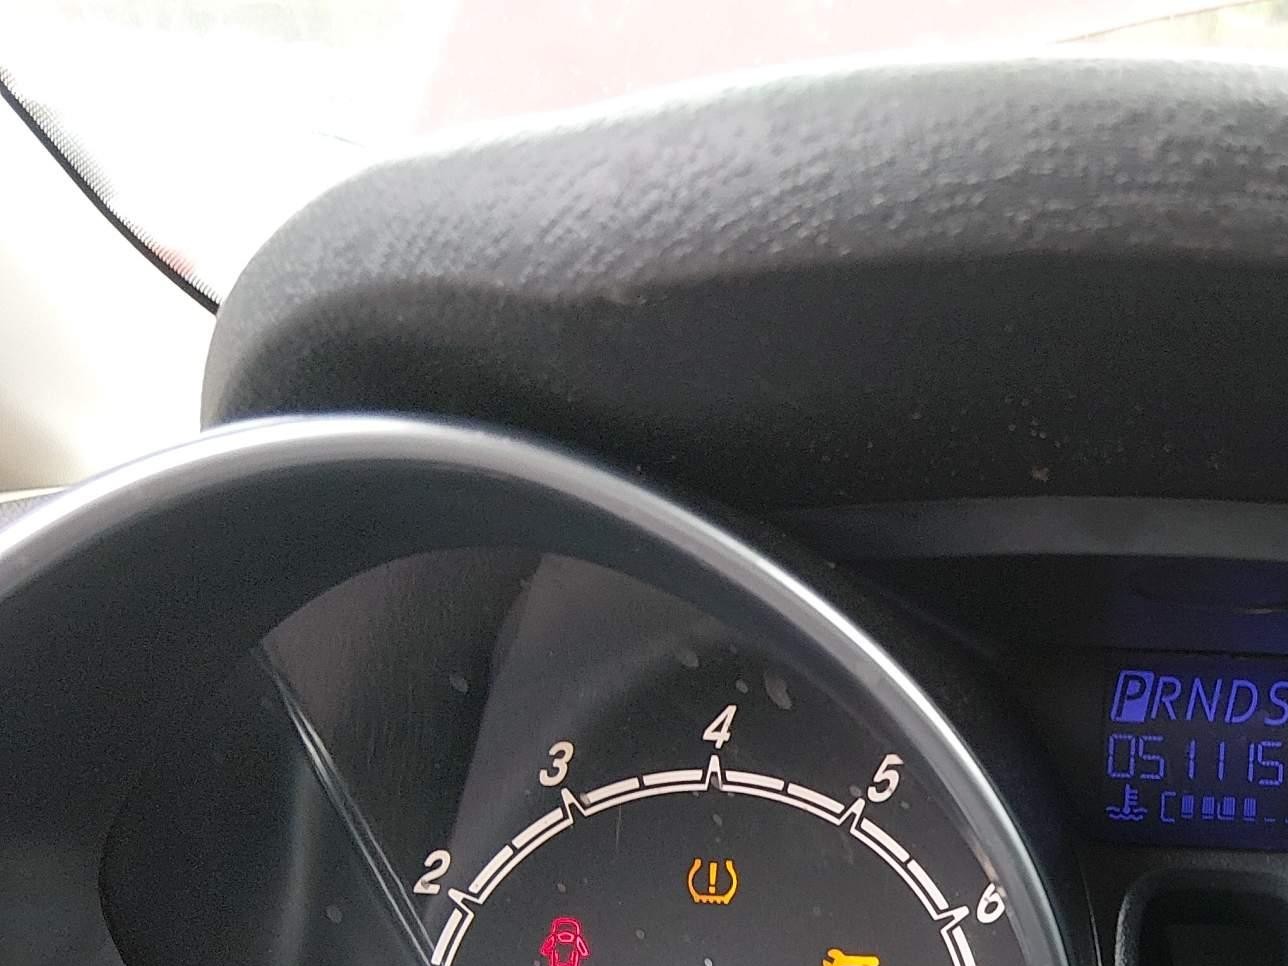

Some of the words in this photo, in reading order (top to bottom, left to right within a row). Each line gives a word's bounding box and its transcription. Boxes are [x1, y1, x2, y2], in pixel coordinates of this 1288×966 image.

[702, 704, 737, 751] 4
[539, 741, 574, 787] 3
[867, 753, 904, 803] 5
[1107, 734, 1284, 786] 051115
[414, 849, 452, 895] 2
[976, 883, 1006, 924] 6
